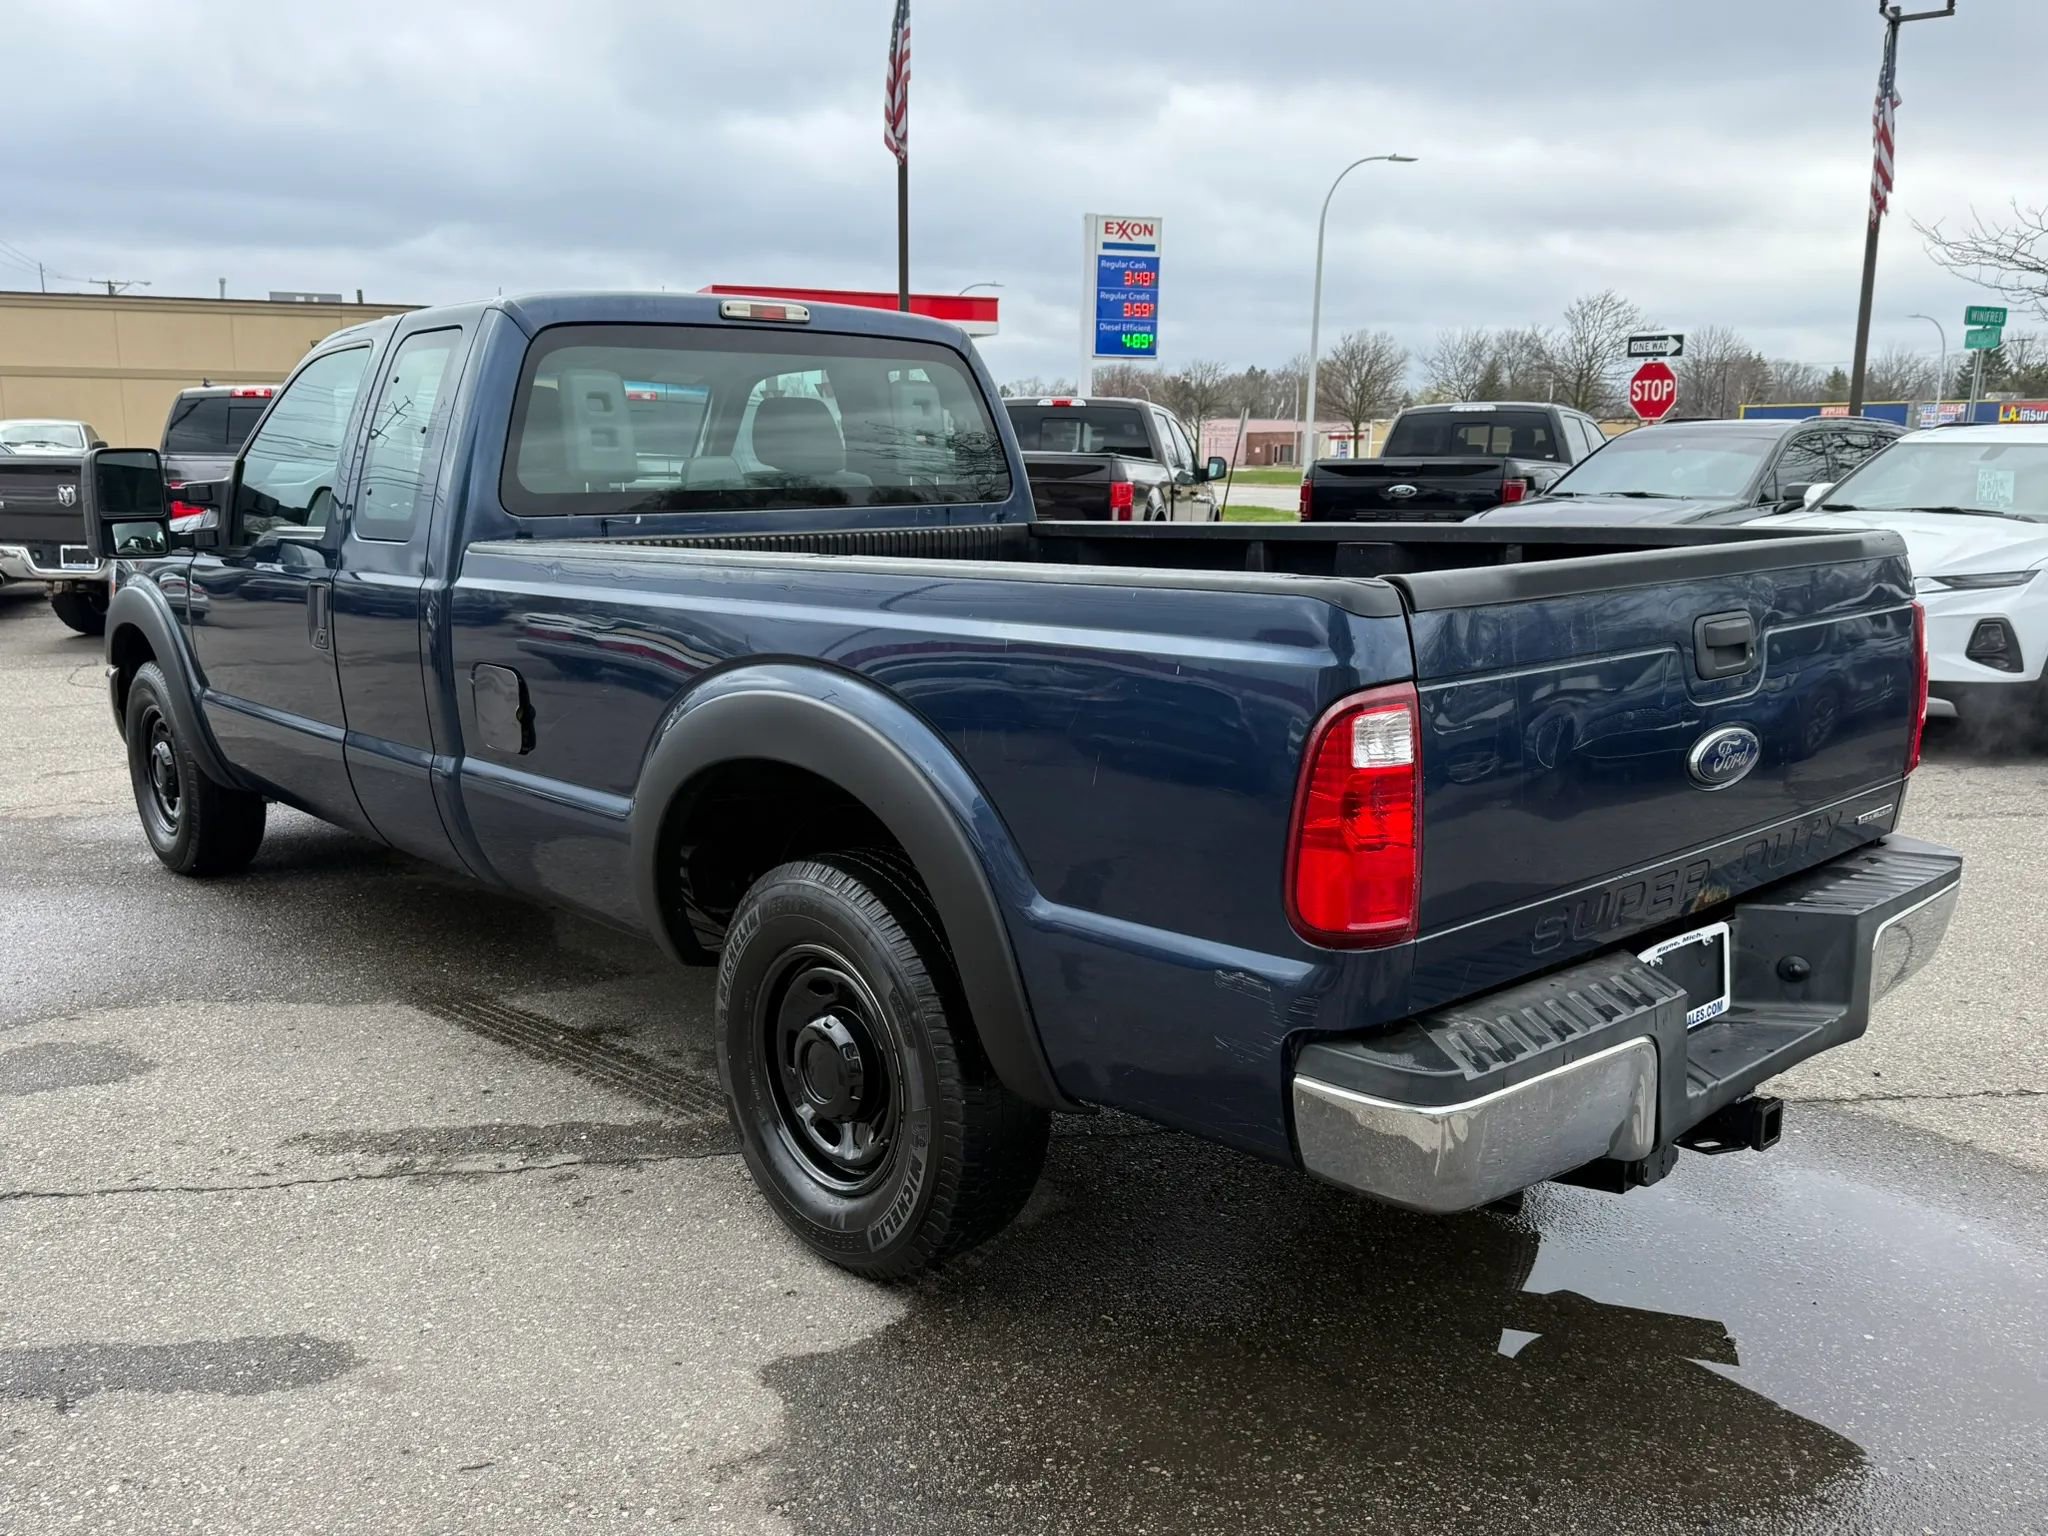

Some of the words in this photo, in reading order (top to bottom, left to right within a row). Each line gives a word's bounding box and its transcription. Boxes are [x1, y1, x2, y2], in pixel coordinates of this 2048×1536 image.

[1104, 220, 1154, 241] EXXON
[1101, 259, 1128, 271] Regular
[1129, 260, 1147, 269] Cash
[1100, 291, 1127, 302] Regular
[1128, 292, 1150, 301] Credit
[1971, 310, 2004, 323] WINIFRED
[1099, 322, 1121, 331] Diesel
[1122, 322, 1151, 332] Efficient
[1632, 342, 1650, 352] ONE
[1652, 342, 1668, 351] WAY
[1632, 379, 1674, 402] STOP
[1713, 738, 1750, 773] Ford
[1531, 858, 1712, 955] SUPER
[1682, 932, 1704, 943] Mich.
[868, 1152, 923, 1248] MICHELIN
